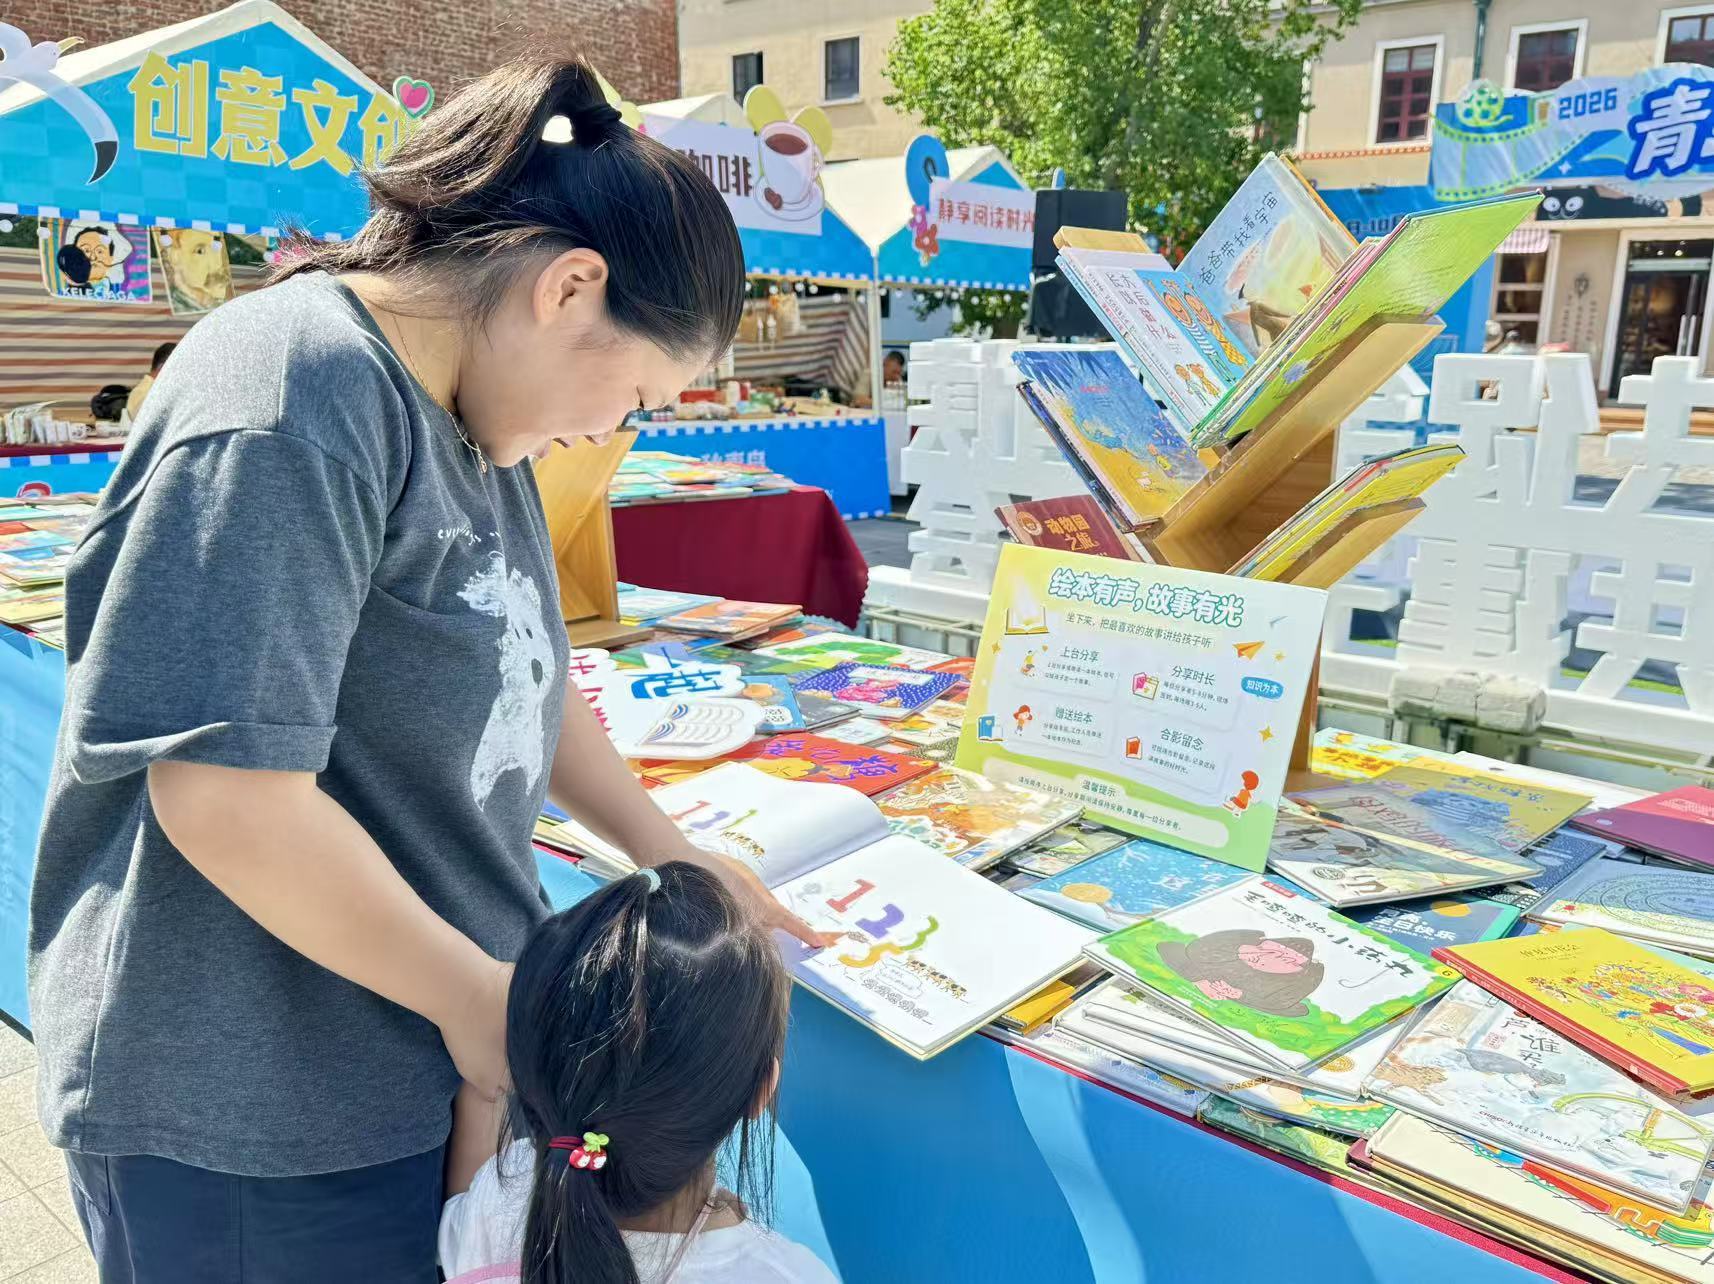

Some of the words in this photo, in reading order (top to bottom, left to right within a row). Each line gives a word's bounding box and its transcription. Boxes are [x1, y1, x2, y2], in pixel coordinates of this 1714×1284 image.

[1558, 87, 1617, 120] 2026
[1633, 84, 1714, 174] 青
[1200, 191, 1278, 285] 爸爸带我看宇宙
[1044, 513, 1090, 535] 动物园
[1065, 531, 1098, 551] 之旅
[1048, 567, 1245, 628] 绘本有声，故事有光
[1060, 646, 1100, 662] 上台分享
[1171, 665, 1216, 686] 分享时长
[1055, 706, 1093, 724] 赠送绘本
[1160, 728, 1205, 751] 合影留念
[1081, 779, 1117, 797] 温馨提示
